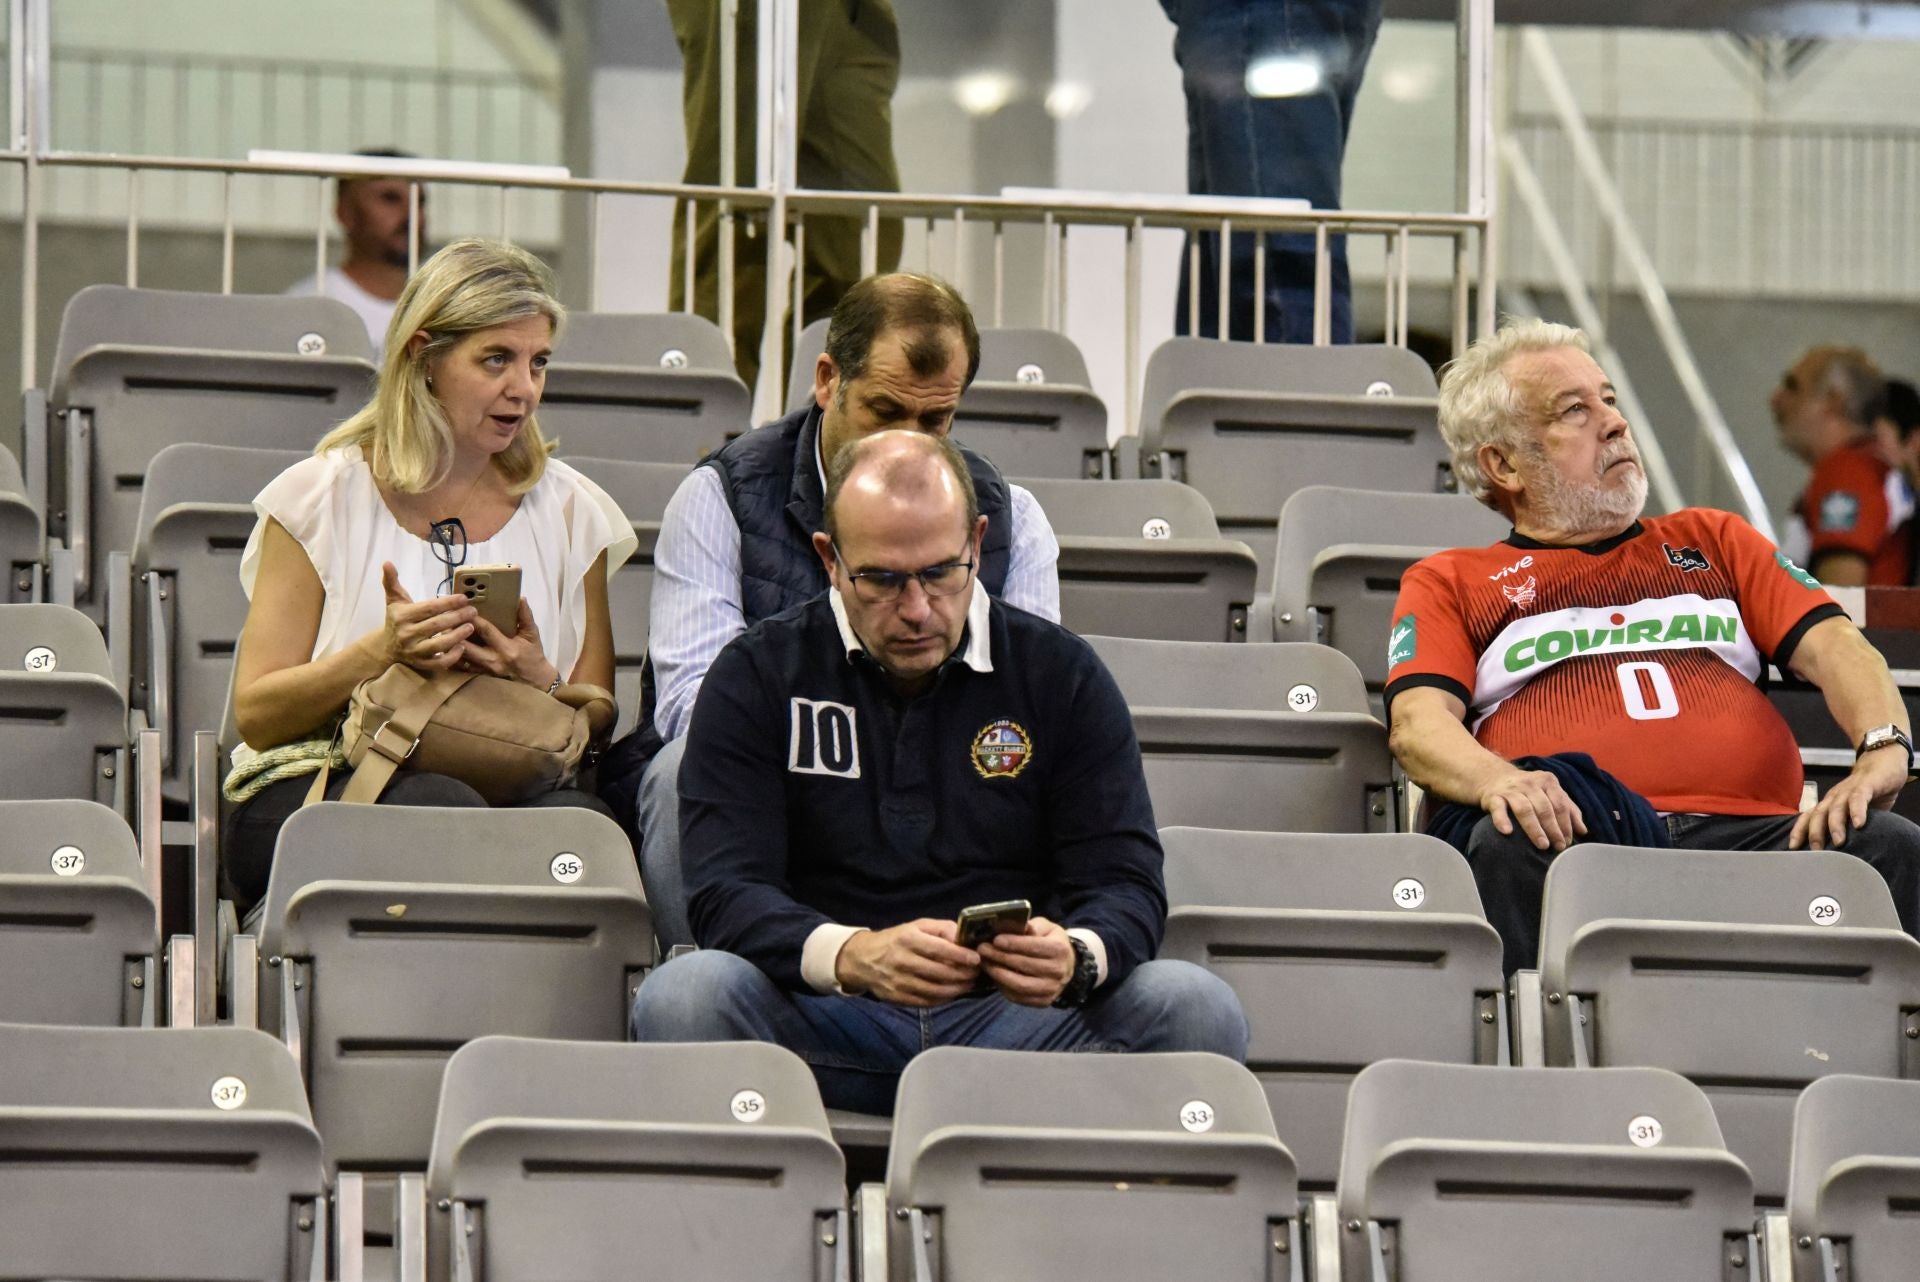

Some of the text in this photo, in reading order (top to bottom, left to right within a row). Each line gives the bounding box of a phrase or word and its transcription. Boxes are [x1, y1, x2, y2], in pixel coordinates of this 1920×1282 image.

[1150, 526, 1165, 538] 31
[1488, 555, 1534, 581] vive
[32, 655, 49, 668] 37
[1616, 661, 1680, 720] 0
[1295, 692, 1311, 704] 31
[795, 701, 856, 775] 10
[59, 855, 78, 869] 37
[557, 862, 578, 875] 35
[1401, 888, 1418, 900] 31
[1815, 904, 1835, 918] 29
[220, 1086, 239, 1101] 37
[738, 1098, 759, 1114] 35
[1187, 1110, 1208, 1124] 33
[1637, 1125, 1655, 1139] 31
